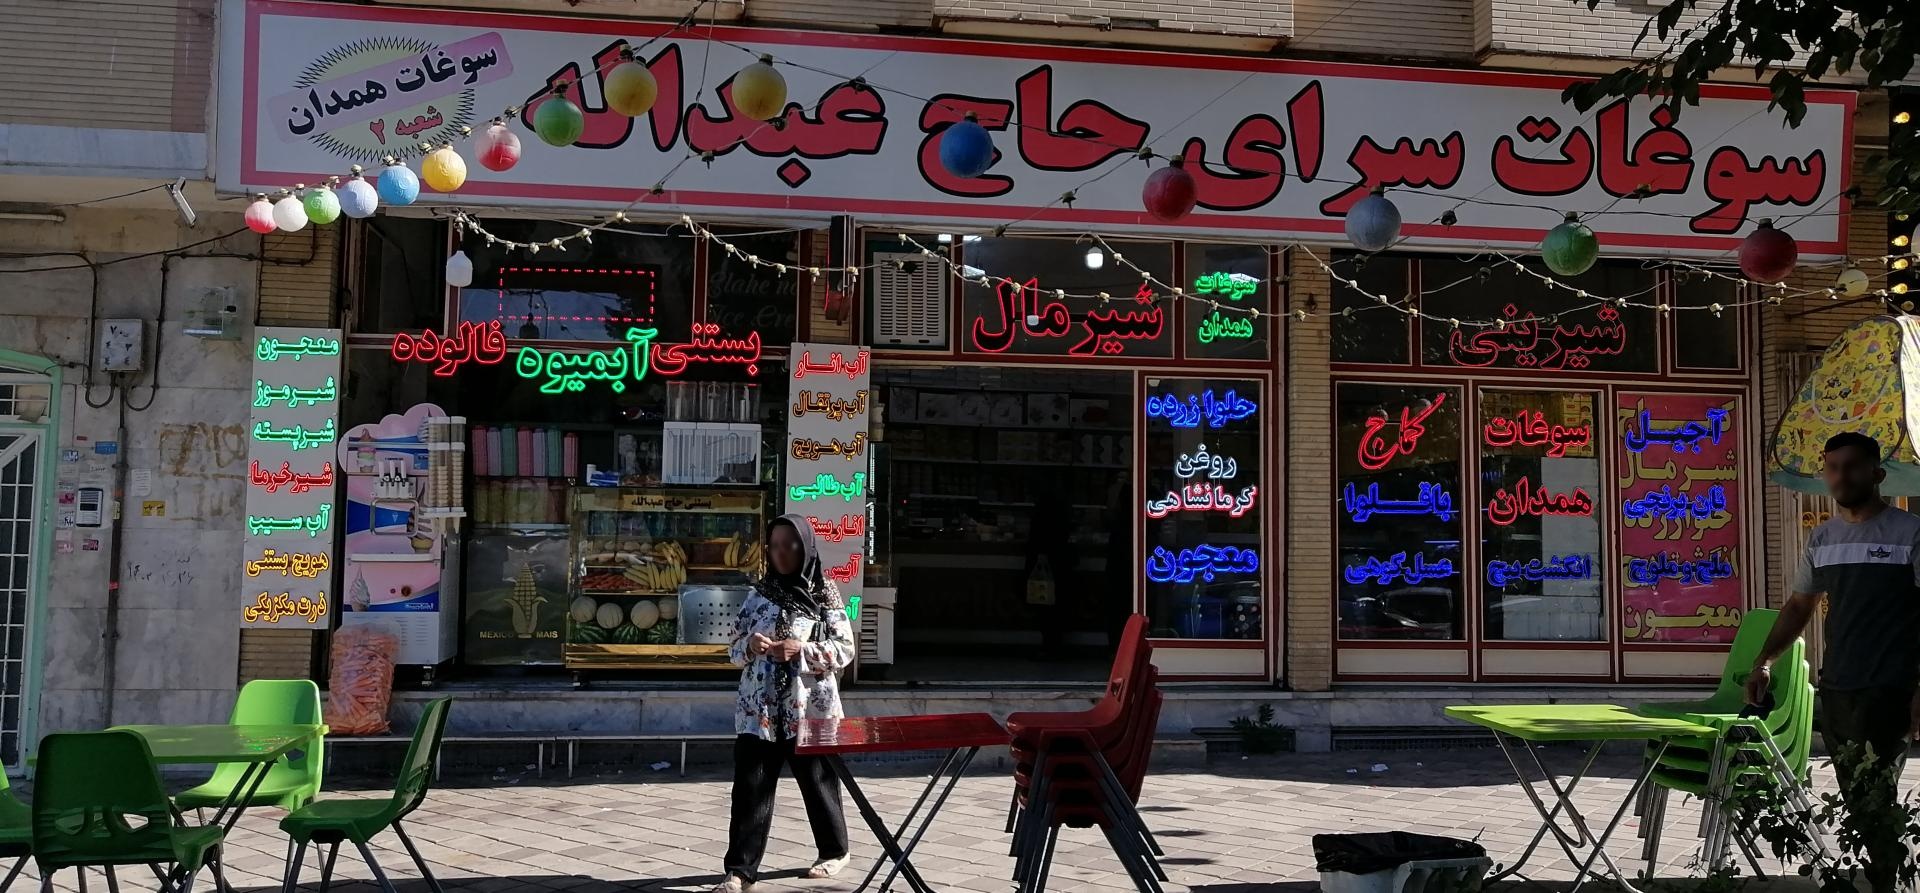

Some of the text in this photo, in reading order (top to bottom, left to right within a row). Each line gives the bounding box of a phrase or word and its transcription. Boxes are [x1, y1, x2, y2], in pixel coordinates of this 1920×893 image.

[286, 43, 497, 137] سوغات همدان
[369, 107, 443, 145] شعبه ۲
[521, 38, 1827, 234] سوغات سرای حاج عبدالله
[1195, 272, 1257, 300] سوغات
[1198, 311, 1253, 343] همدان
[1450, 303, 1627, 370] شیرینی
[257, 336, 339, 361] معجون
[391, 319, 507, 376] فالوده
[515, 327, 658, 393] آبمیوه
[650, 321, 761, 375] بستنی
[794, 351, 868, 379] آب انار
[793, 390, 843, 421] پرتقال
[1484, 410, 1590, 457] سوغات
[1625, 408, 1728, 453] آجیل
[791, 438, 841, 461] هویج
[1175, 444, 1237, 478] روغن
[789, 473, 840, 501] طالبی
[1344, 482, 1451, 522] باقلوا
[1488, 476, 1594, 525] همدان
[305, 503, 332, 537] آب
[807, 515, 833, 542] بست
[246, 549, 329, 578] هویج بستنی
[1146, 544, 1259, 583] معجون
[244, 591, 327, 623] ذرت مکزیکی
[1623, 603, 1742, 639] معجون
[479, 630, 559, 640] MEXICO MAIS
